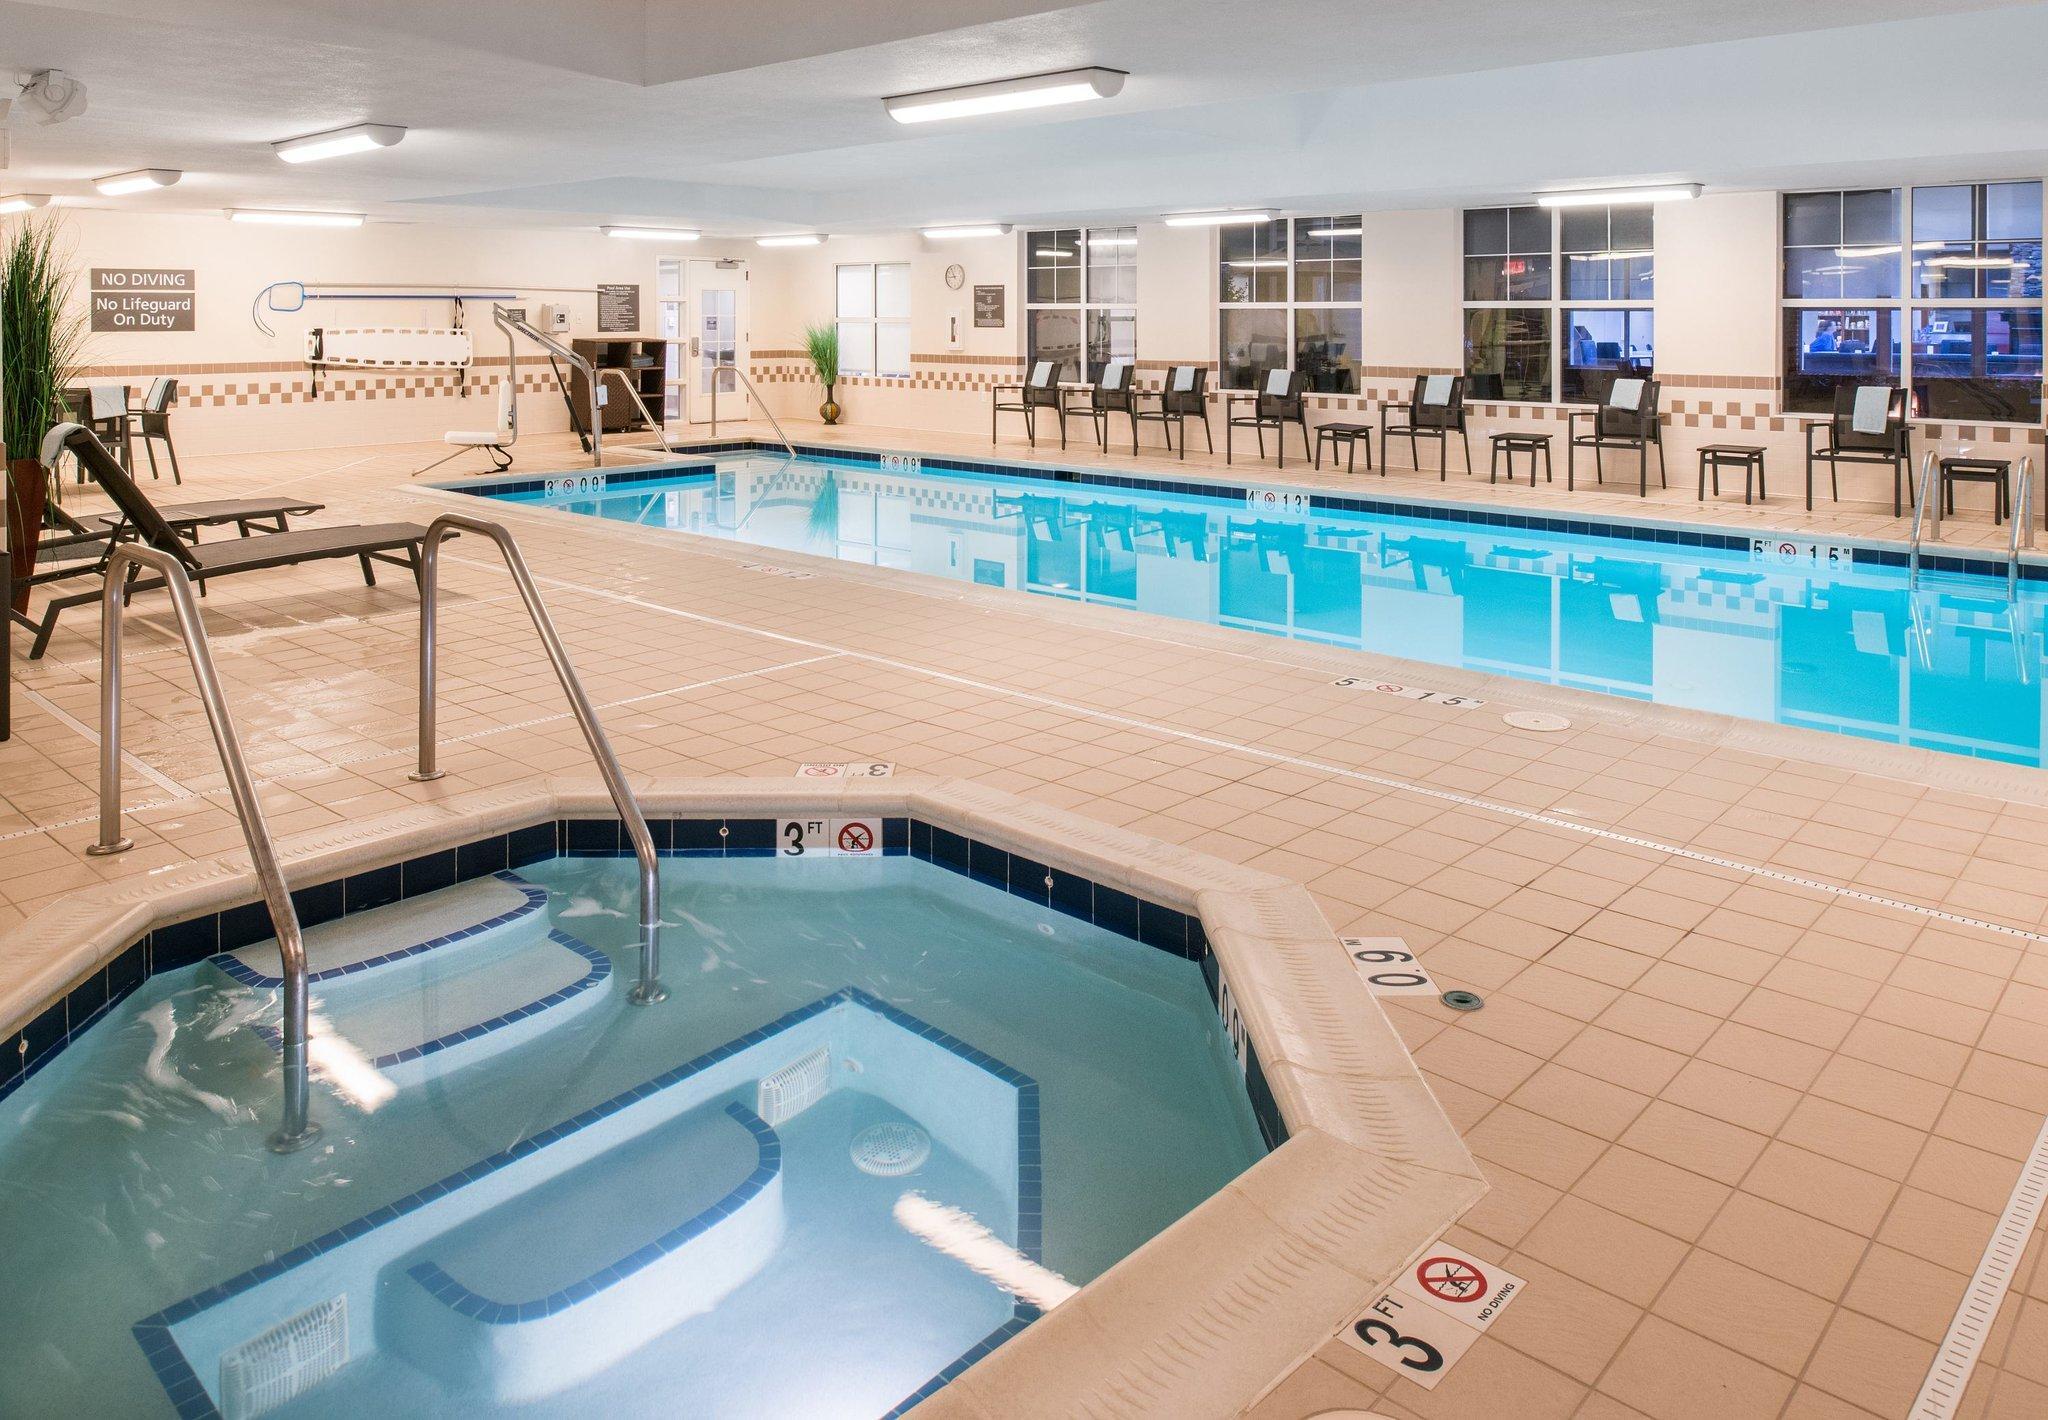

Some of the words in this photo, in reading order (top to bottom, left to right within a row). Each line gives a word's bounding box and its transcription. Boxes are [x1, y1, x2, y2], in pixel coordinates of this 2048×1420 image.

[101, 272, 126, 286] NO
[131, 273, 186, 286] DIVING
[96, 298, 118, 311] No
[122, 298, 191, 313] Lifeguard
[113, 313, 136, 326] On
[140, 314, 175, 328] Duty
[868, 763, 889, 777] 3
[783, 821, 805, 856] 3
[807, 821, 823, 834] FT
[1371, 1294, 1404, 1319] FT
[1477, 1307, 1493, 1322] NO
[1488, 1282, 1515, 1309] DIVING
[1354, 1318, 1444, 1372] 3
